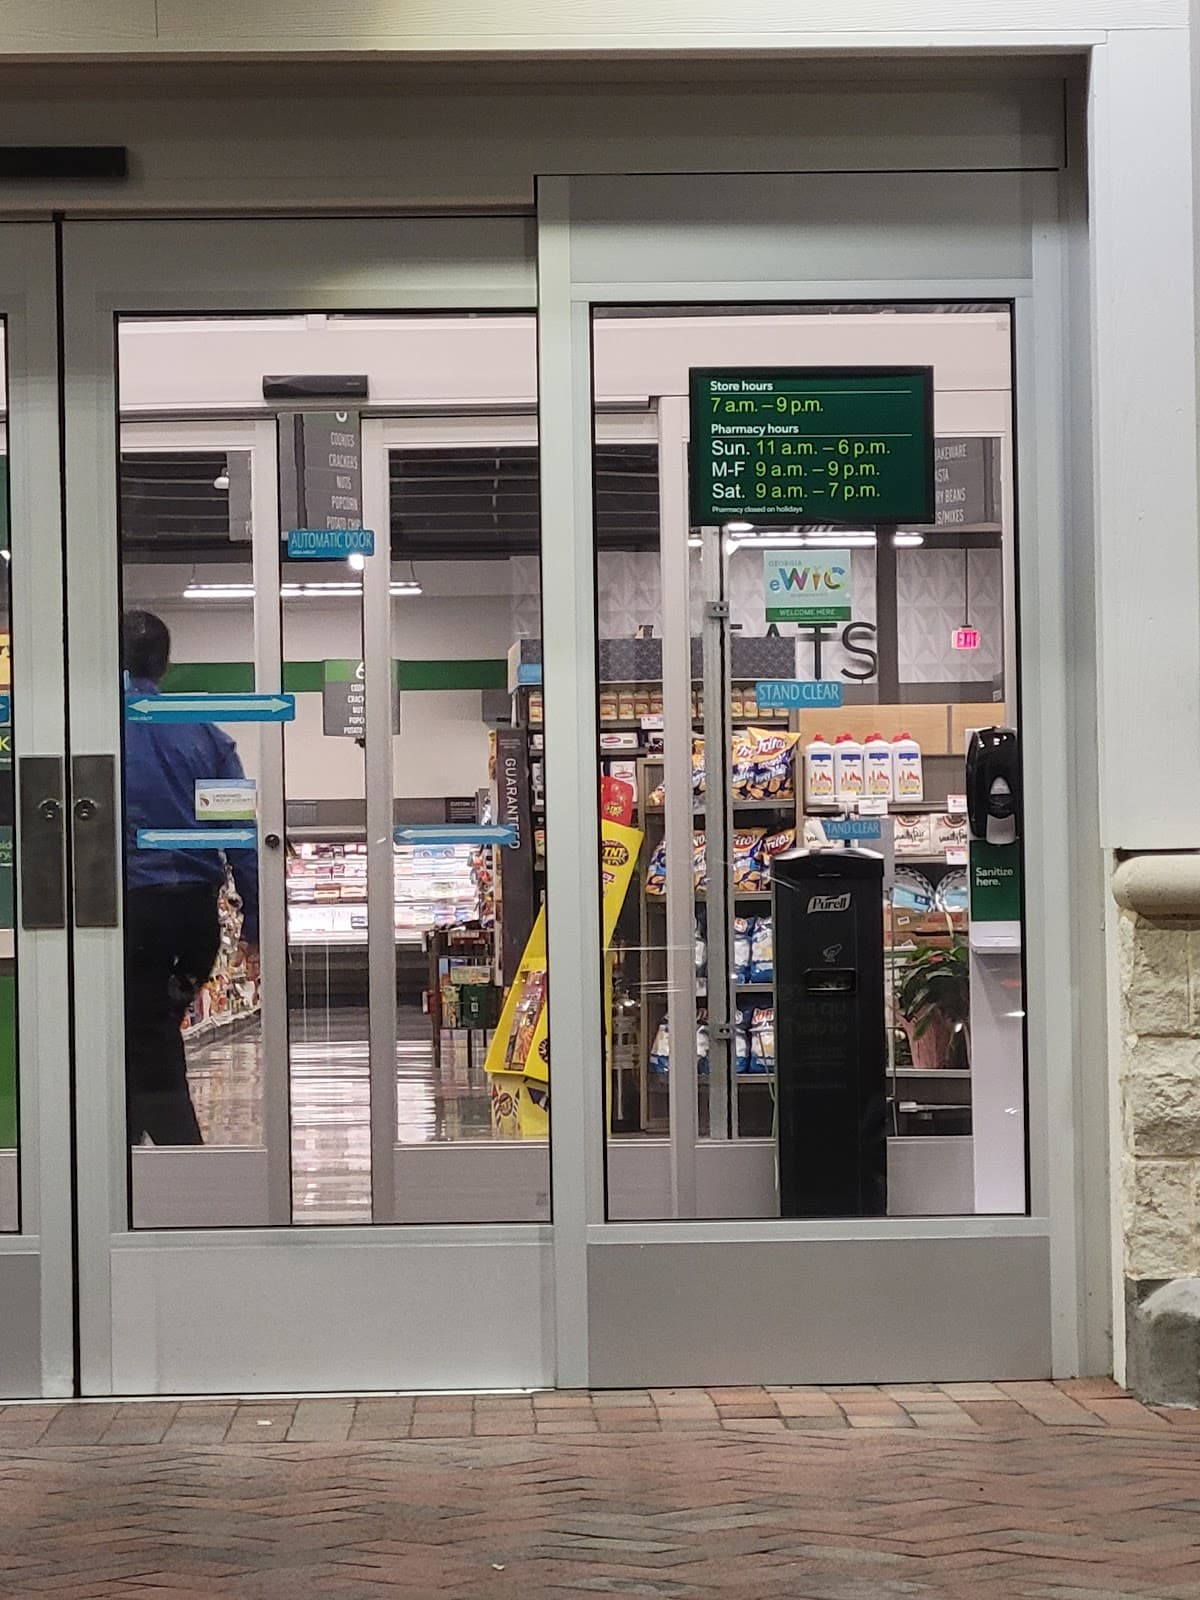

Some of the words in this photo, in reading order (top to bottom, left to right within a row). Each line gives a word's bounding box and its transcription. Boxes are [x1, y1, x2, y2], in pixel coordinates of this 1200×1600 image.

[710, 381, 739, 391] Store
[742, 381, 773, 391] hours
[711, 397, 721, 412] 7
[725, 401, 758, 412] a.m.
[776, 396, 787, 412] 9
[791, 399, 824, 415] p.m.
[711, 424, 765, 436] Pharmacy
[767, 424, 799, 434] hours
[712, 440, 750, 455] Sun.
[756, 440, 775, 455] 11
[781, 442, 818, 455] a.m.
[838, 439, 849, 454] 6
[854, 441, 890, 457] p.m.
[712, 461, 746, 477] M-F
[755, 461, 766, 477] 9
[771, 465, 808, 477] a.m.
[828, 461, 839, 476] 9
[843, 463, 880, 479] p.m.
[712, 483, 746, 498] Sat.
[755, 483, 766, 498] 9
[771, 486, 808, 498] a.m.
[829, 482, 839, 498] 7
[844, 485, 880, 501] p.m.
[712, 506, 743, 514] Pharmacy
[776, 506, 803, 514] holidays
[291, 532, 343, 548] AUTOMATIC
[345, 531, 373, 548] DOOR
[957, 631, 977, 648] EXIT
[757, 684, 799, 701] STAND
[803, 684, 839, 700] CLEAR
[976, 867, 1013, 877] Sanitize
[976, 877, 1001, 887] here.
[812, 897, 847, 910] Purell
